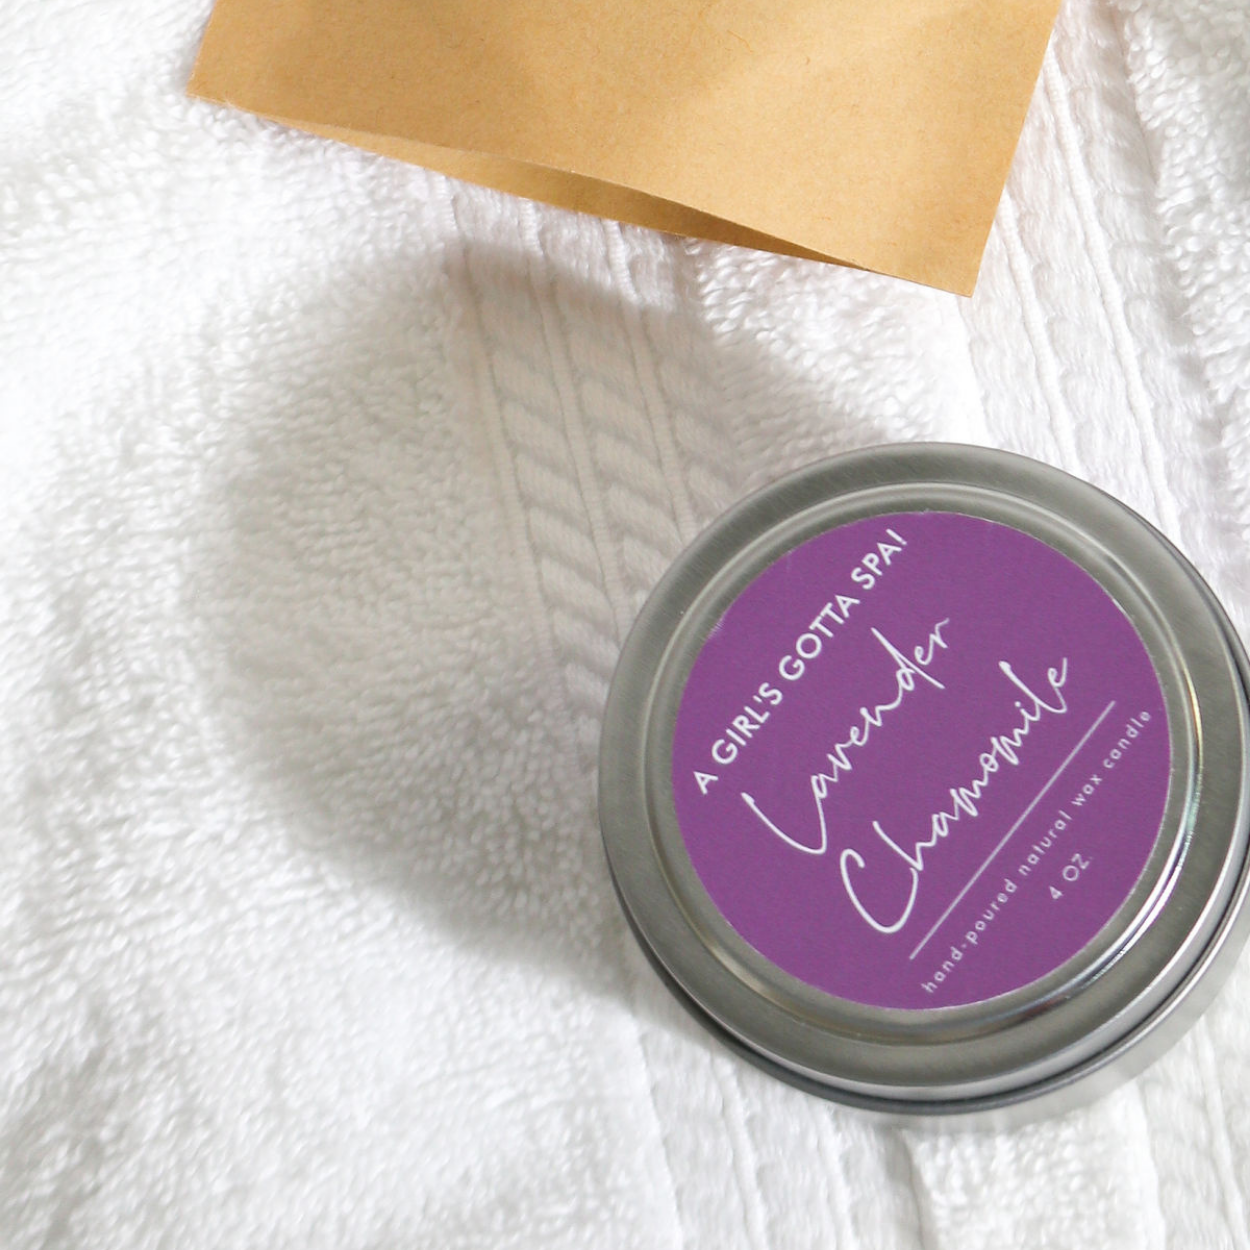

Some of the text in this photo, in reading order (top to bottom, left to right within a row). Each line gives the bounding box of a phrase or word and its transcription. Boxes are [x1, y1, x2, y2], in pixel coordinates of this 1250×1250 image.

[692, 528, 908, 796] A GIRL'S GOTTA SPA!
[740, 617, 950, 856] Lavender
[839, 656, 1068, 935] Chamomile
[920, 711, 1151, 994] hand-poured natural wax candle
[1049, 885, 1064, 900] 4
